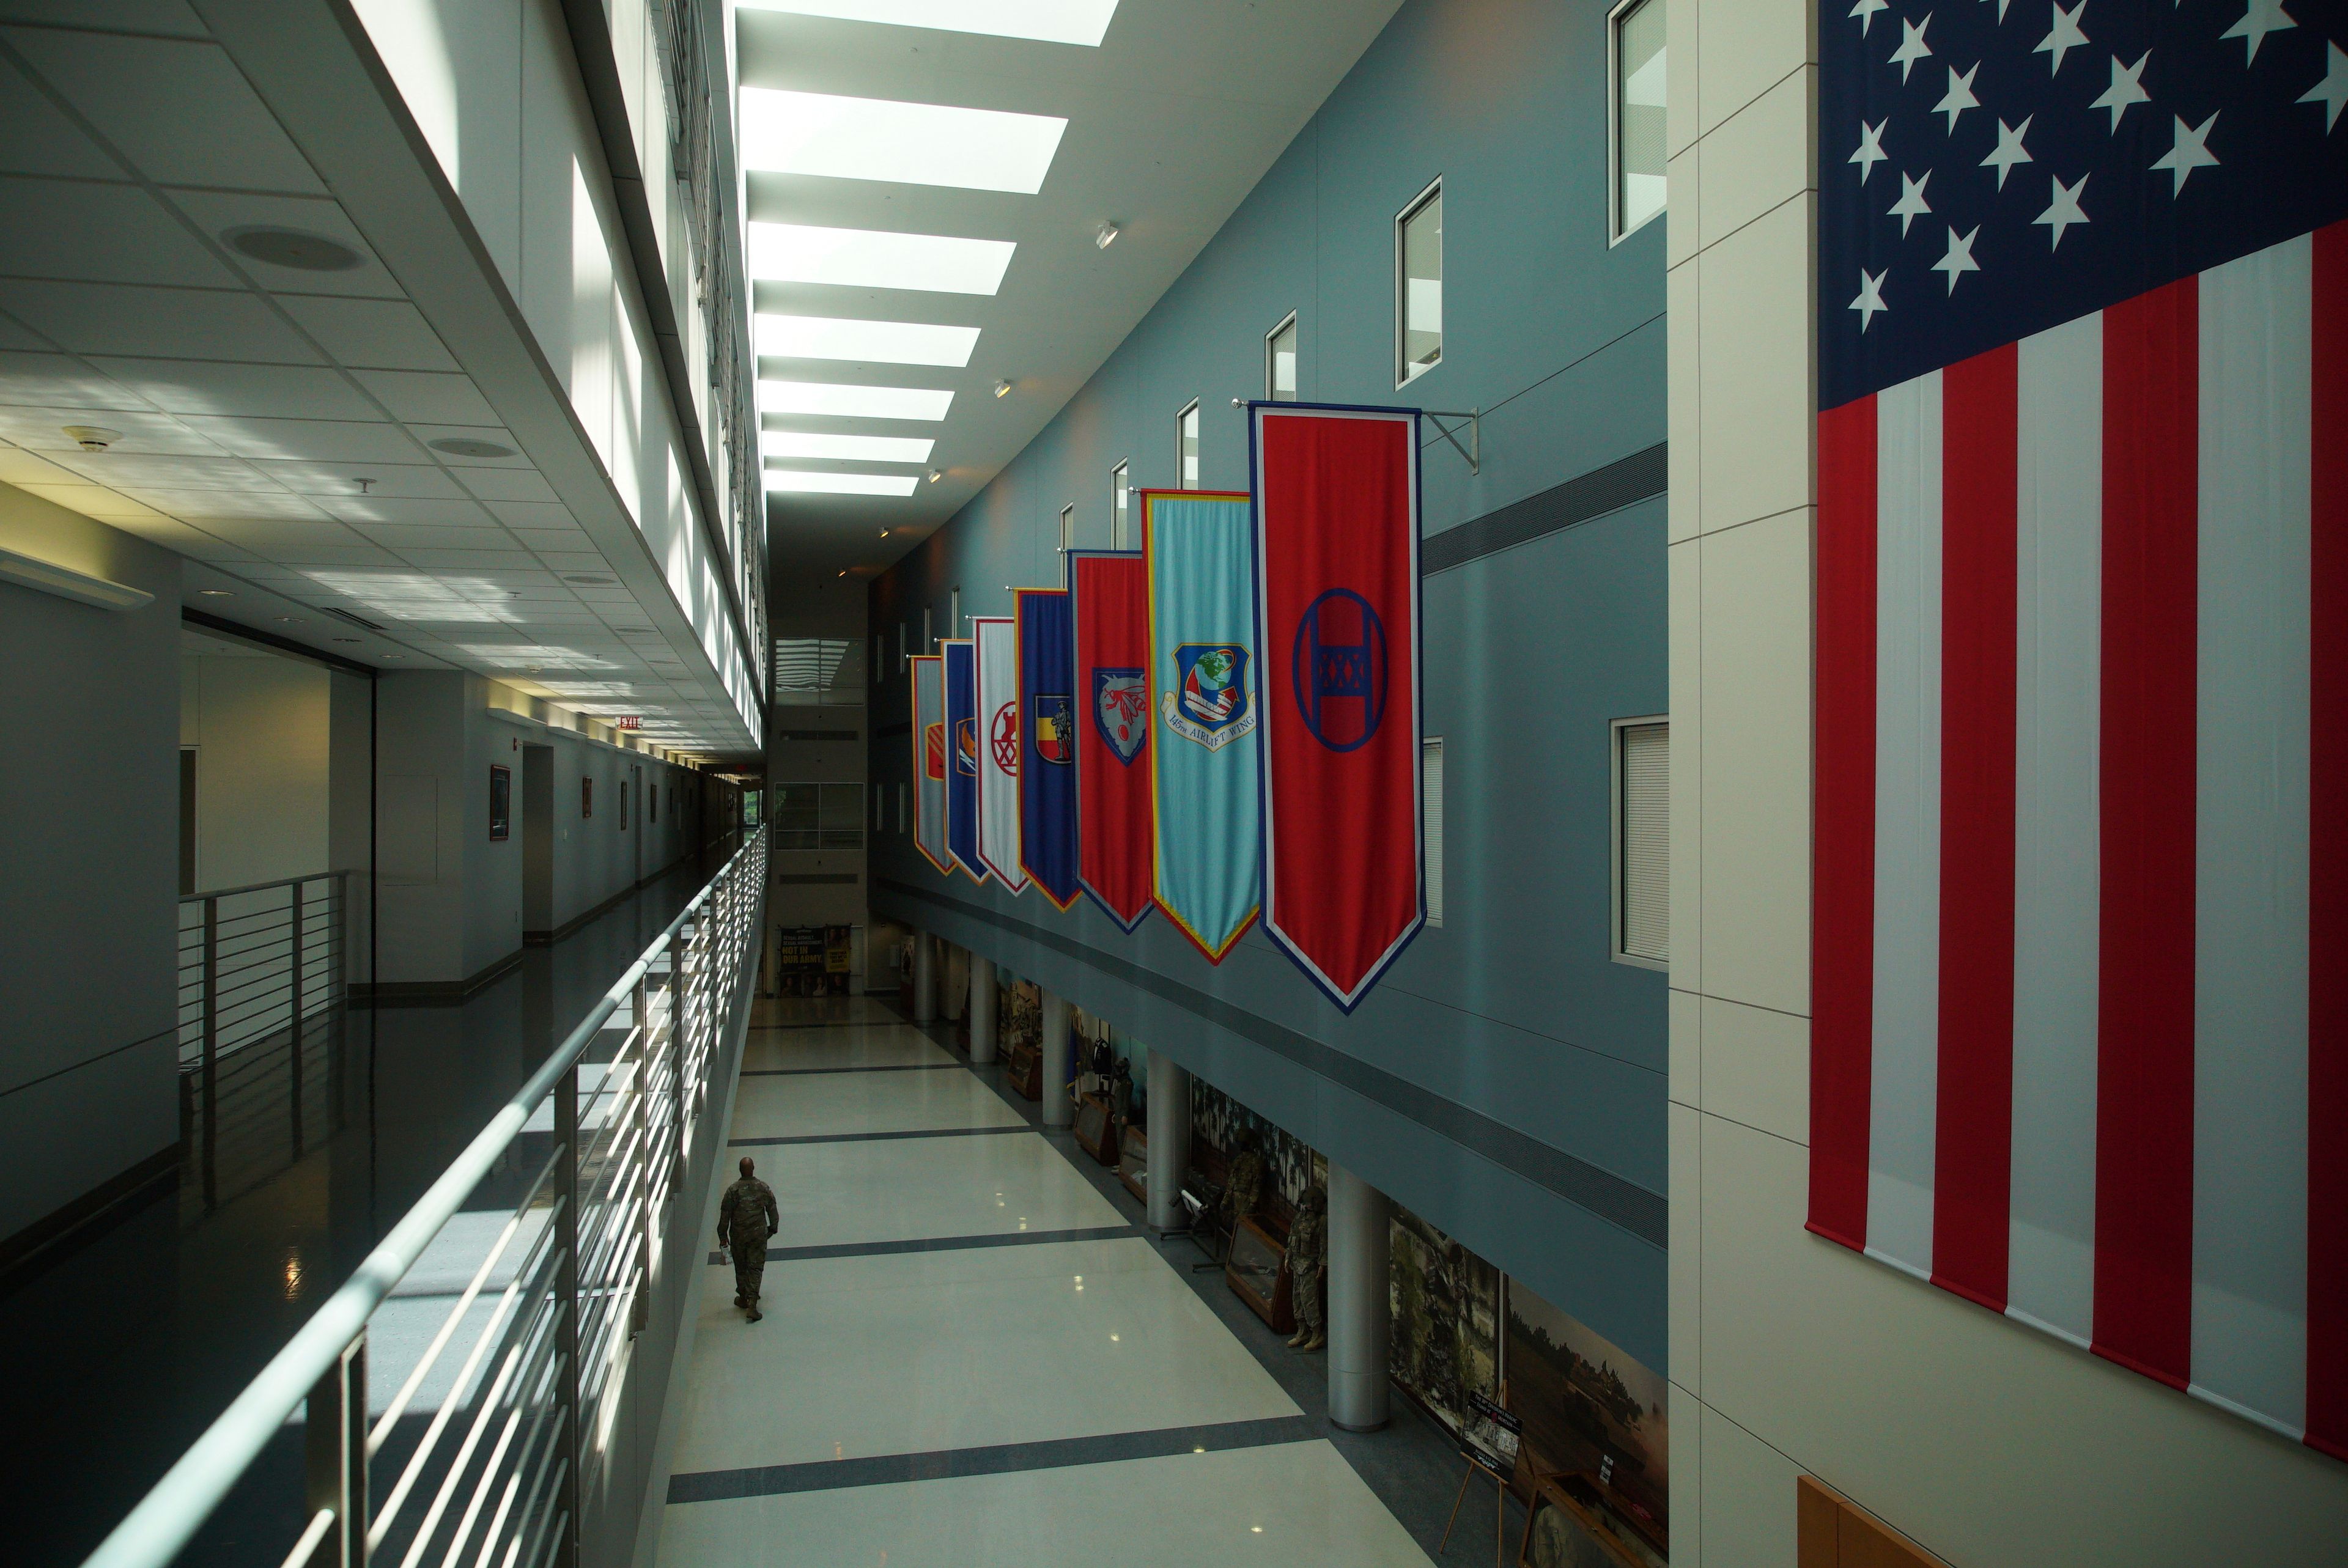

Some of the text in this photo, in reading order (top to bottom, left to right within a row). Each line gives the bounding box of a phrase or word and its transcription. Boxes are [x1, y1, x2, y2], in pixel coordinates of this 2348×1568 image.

[620, 716, 640, 729] EXIT
[1189, 727, 1225, 748] AIRLIFT
[1228, 716, 1255, 737] WING
[782, 946, 808, 954] NOT IN
[783, 955, 799, 964] OUR
